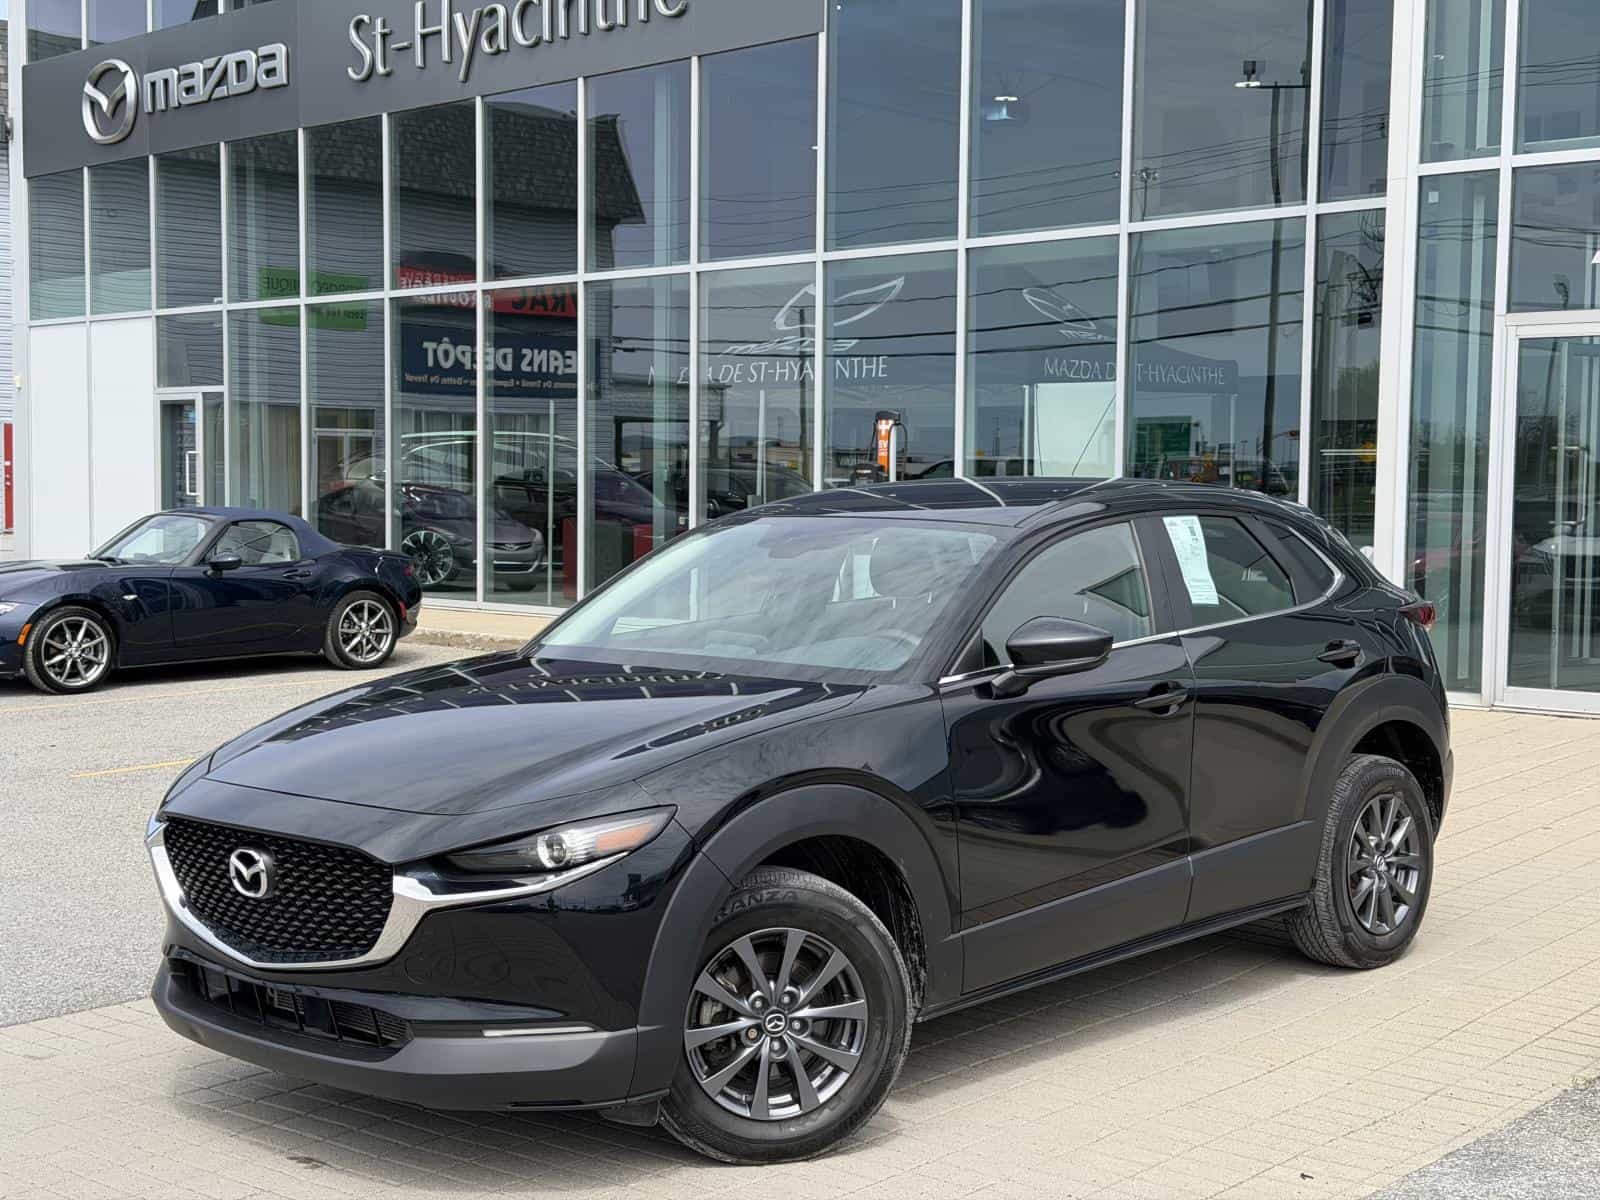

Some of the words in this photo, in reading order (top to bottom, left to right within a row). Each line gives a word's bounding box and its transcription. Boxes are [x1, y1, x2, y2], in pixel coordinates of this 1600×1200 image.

[143, 42, 289, 114] mazda
[719, 362, 743, 384] DE
[747, 355, 889, 384] ST-HYANTHE
[1043, 357, 1102, 380] MAZDA
[1135, 362, 1226, 386] T-HYACINTHE
